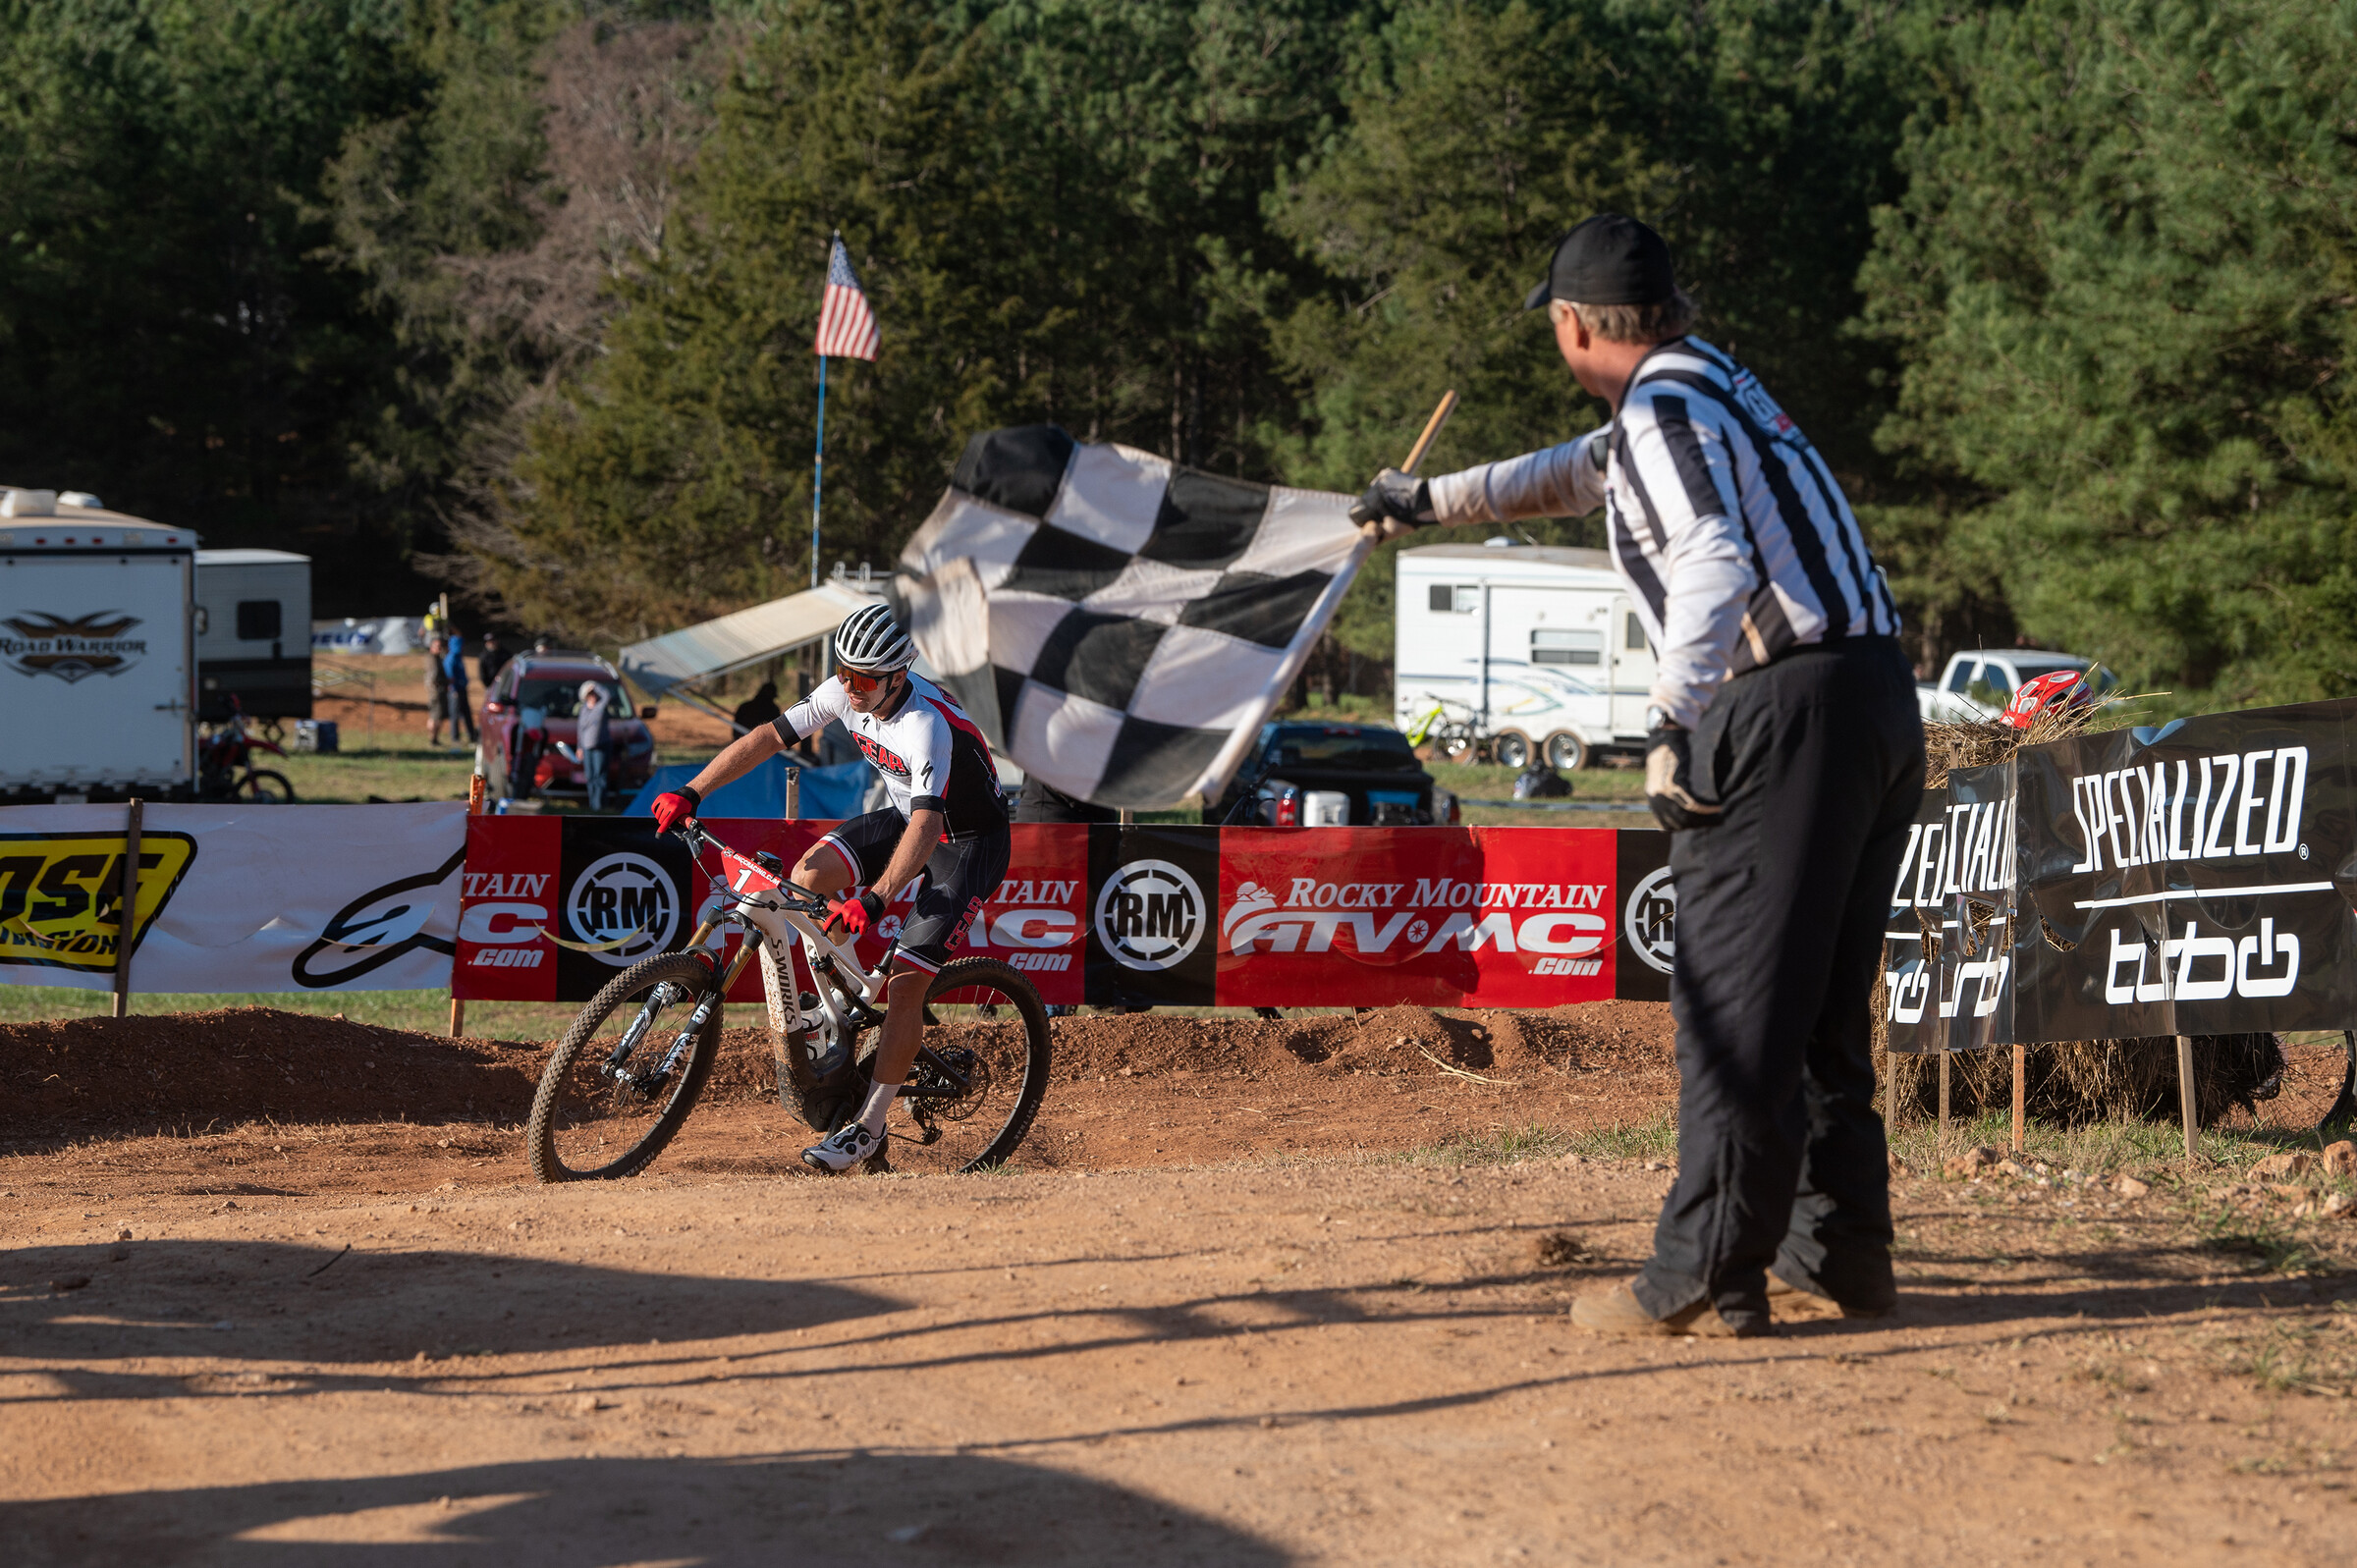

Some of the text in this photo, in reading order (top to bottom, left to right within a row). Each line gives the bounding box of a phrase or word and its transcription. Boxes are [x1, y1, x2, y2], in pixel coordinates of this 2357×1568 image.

[55, 638, 146, 655] WARRIOR
[851, 731, 905, 773] GEAR
[732, 868, 753, 893] 1
[1283, 877, 1607, 909] ROCKY MOUNTAIN
[591, 887, 659, 933] RM
[944, 895, 982, 950] GEAR
[1117, 892, 1182, 938] RM
[1649, 898, 1674, 941] R
[771, 938, 797, 1026] S-WORKS
